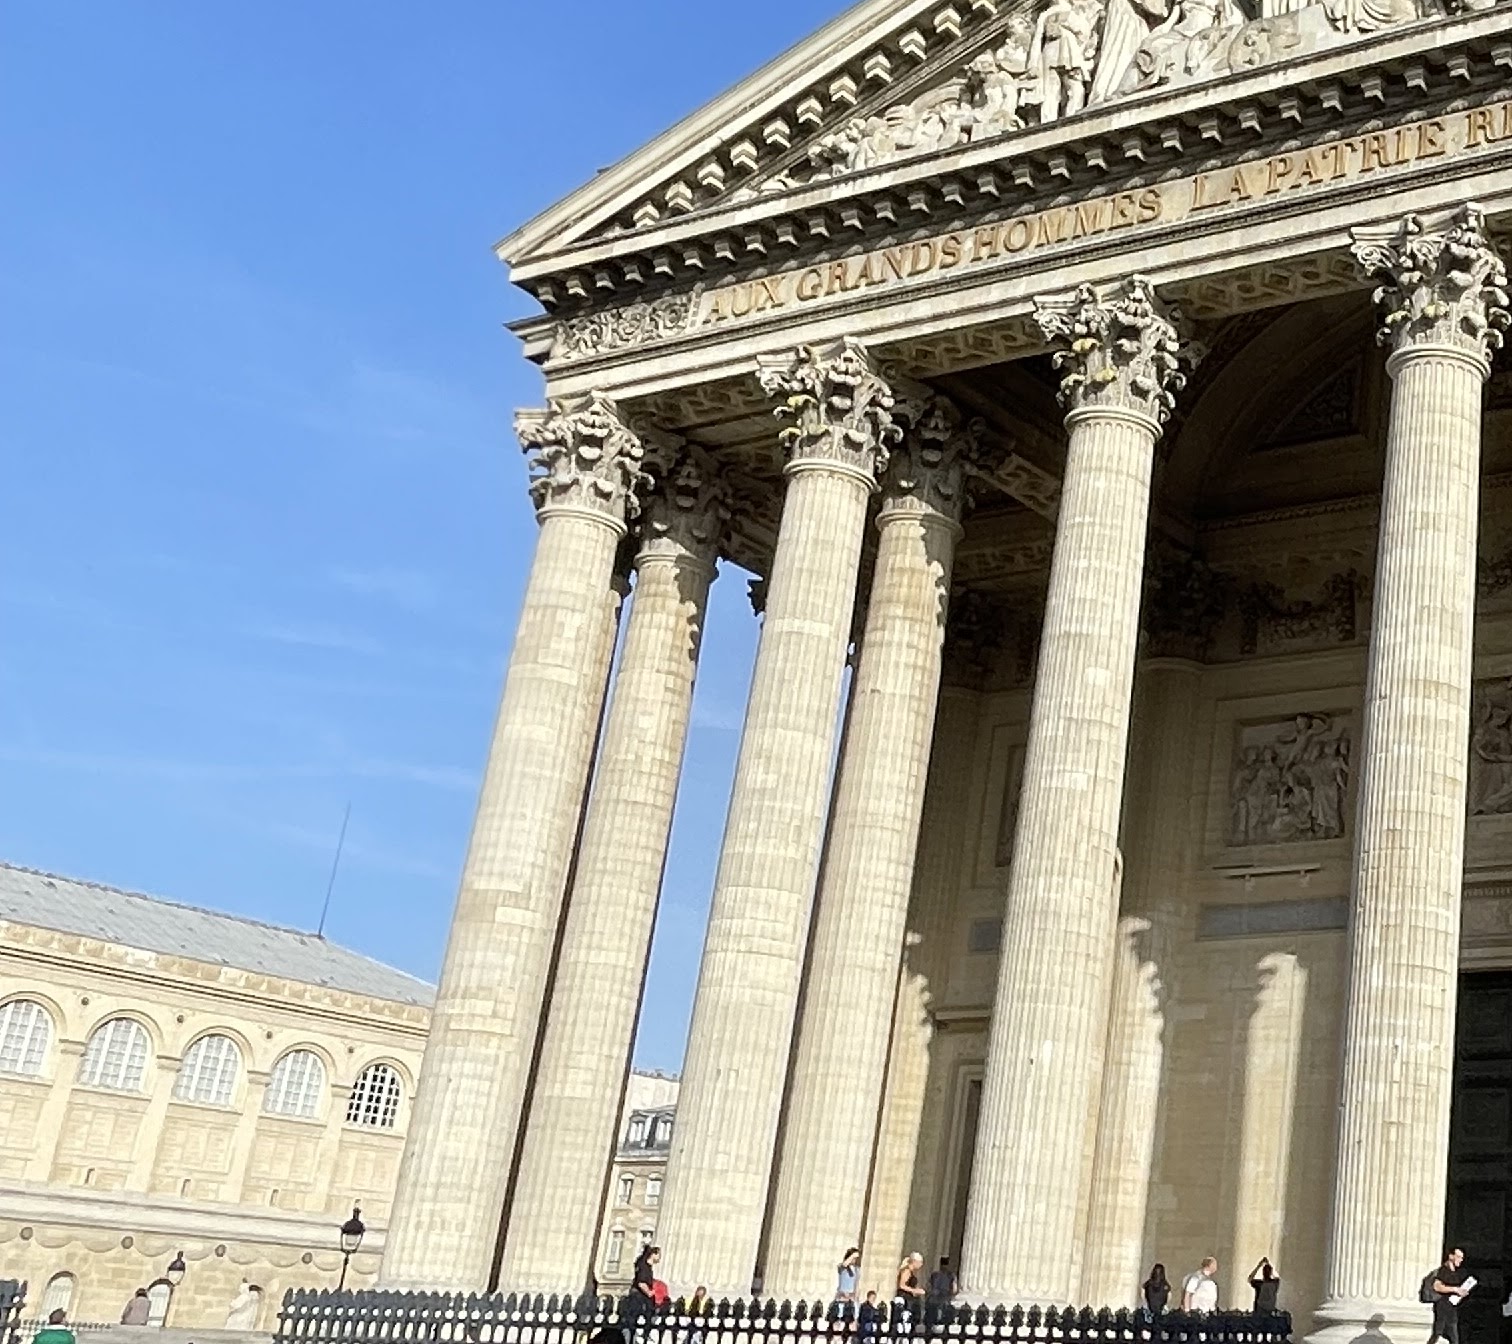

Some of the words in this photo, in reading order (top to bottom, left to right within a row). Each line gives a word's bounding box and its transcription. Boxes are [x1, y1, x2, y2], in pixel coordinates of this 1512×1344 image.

[703, 275, 786, 324] AUX
[796, 235, 962, 301] GRANDS
[970, 188, 1164, 262] HOMMES
[1189, 173, 1252, 212] LA
[1263, 120, 1446, 195] PATRIE
